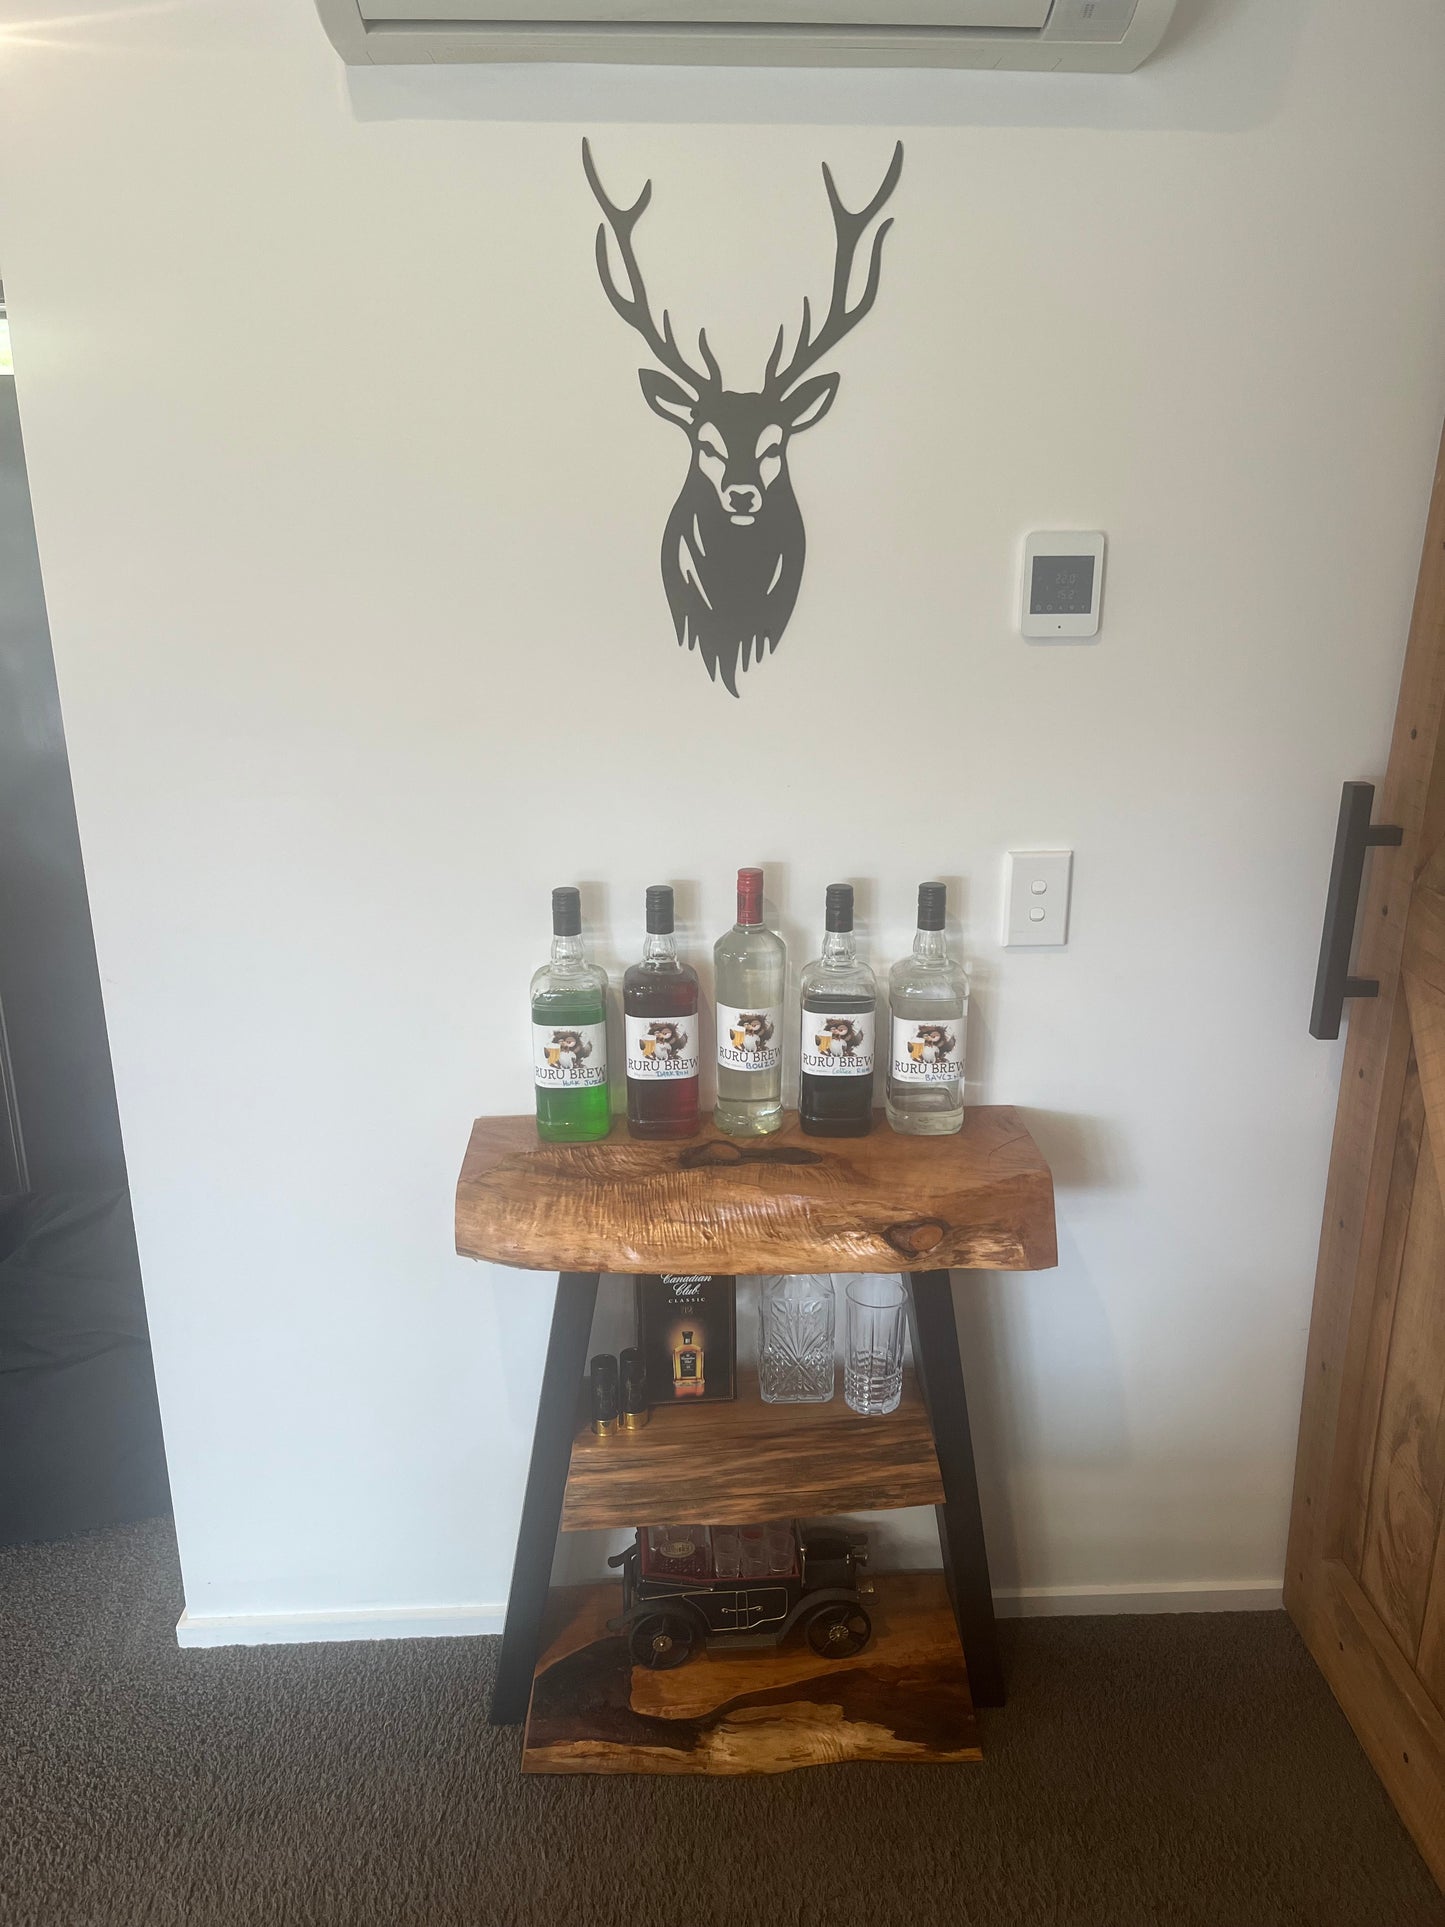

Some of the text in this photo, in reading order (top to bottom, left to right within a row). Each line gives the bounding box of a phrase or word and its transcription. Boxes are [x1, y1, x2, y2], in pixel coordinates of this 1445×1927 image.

[719, 1045, 782, 1063] RURU BREW
[803, 1053, 874, 1068] RURU BREW
[535, 1064, 607, 1080] RURU BREW
[628, 1056, 699, 1072] RURU BREW
[895, 1058, 965, 1074] RURU BREW
[660, 1274, 712, 1284] Canadian
